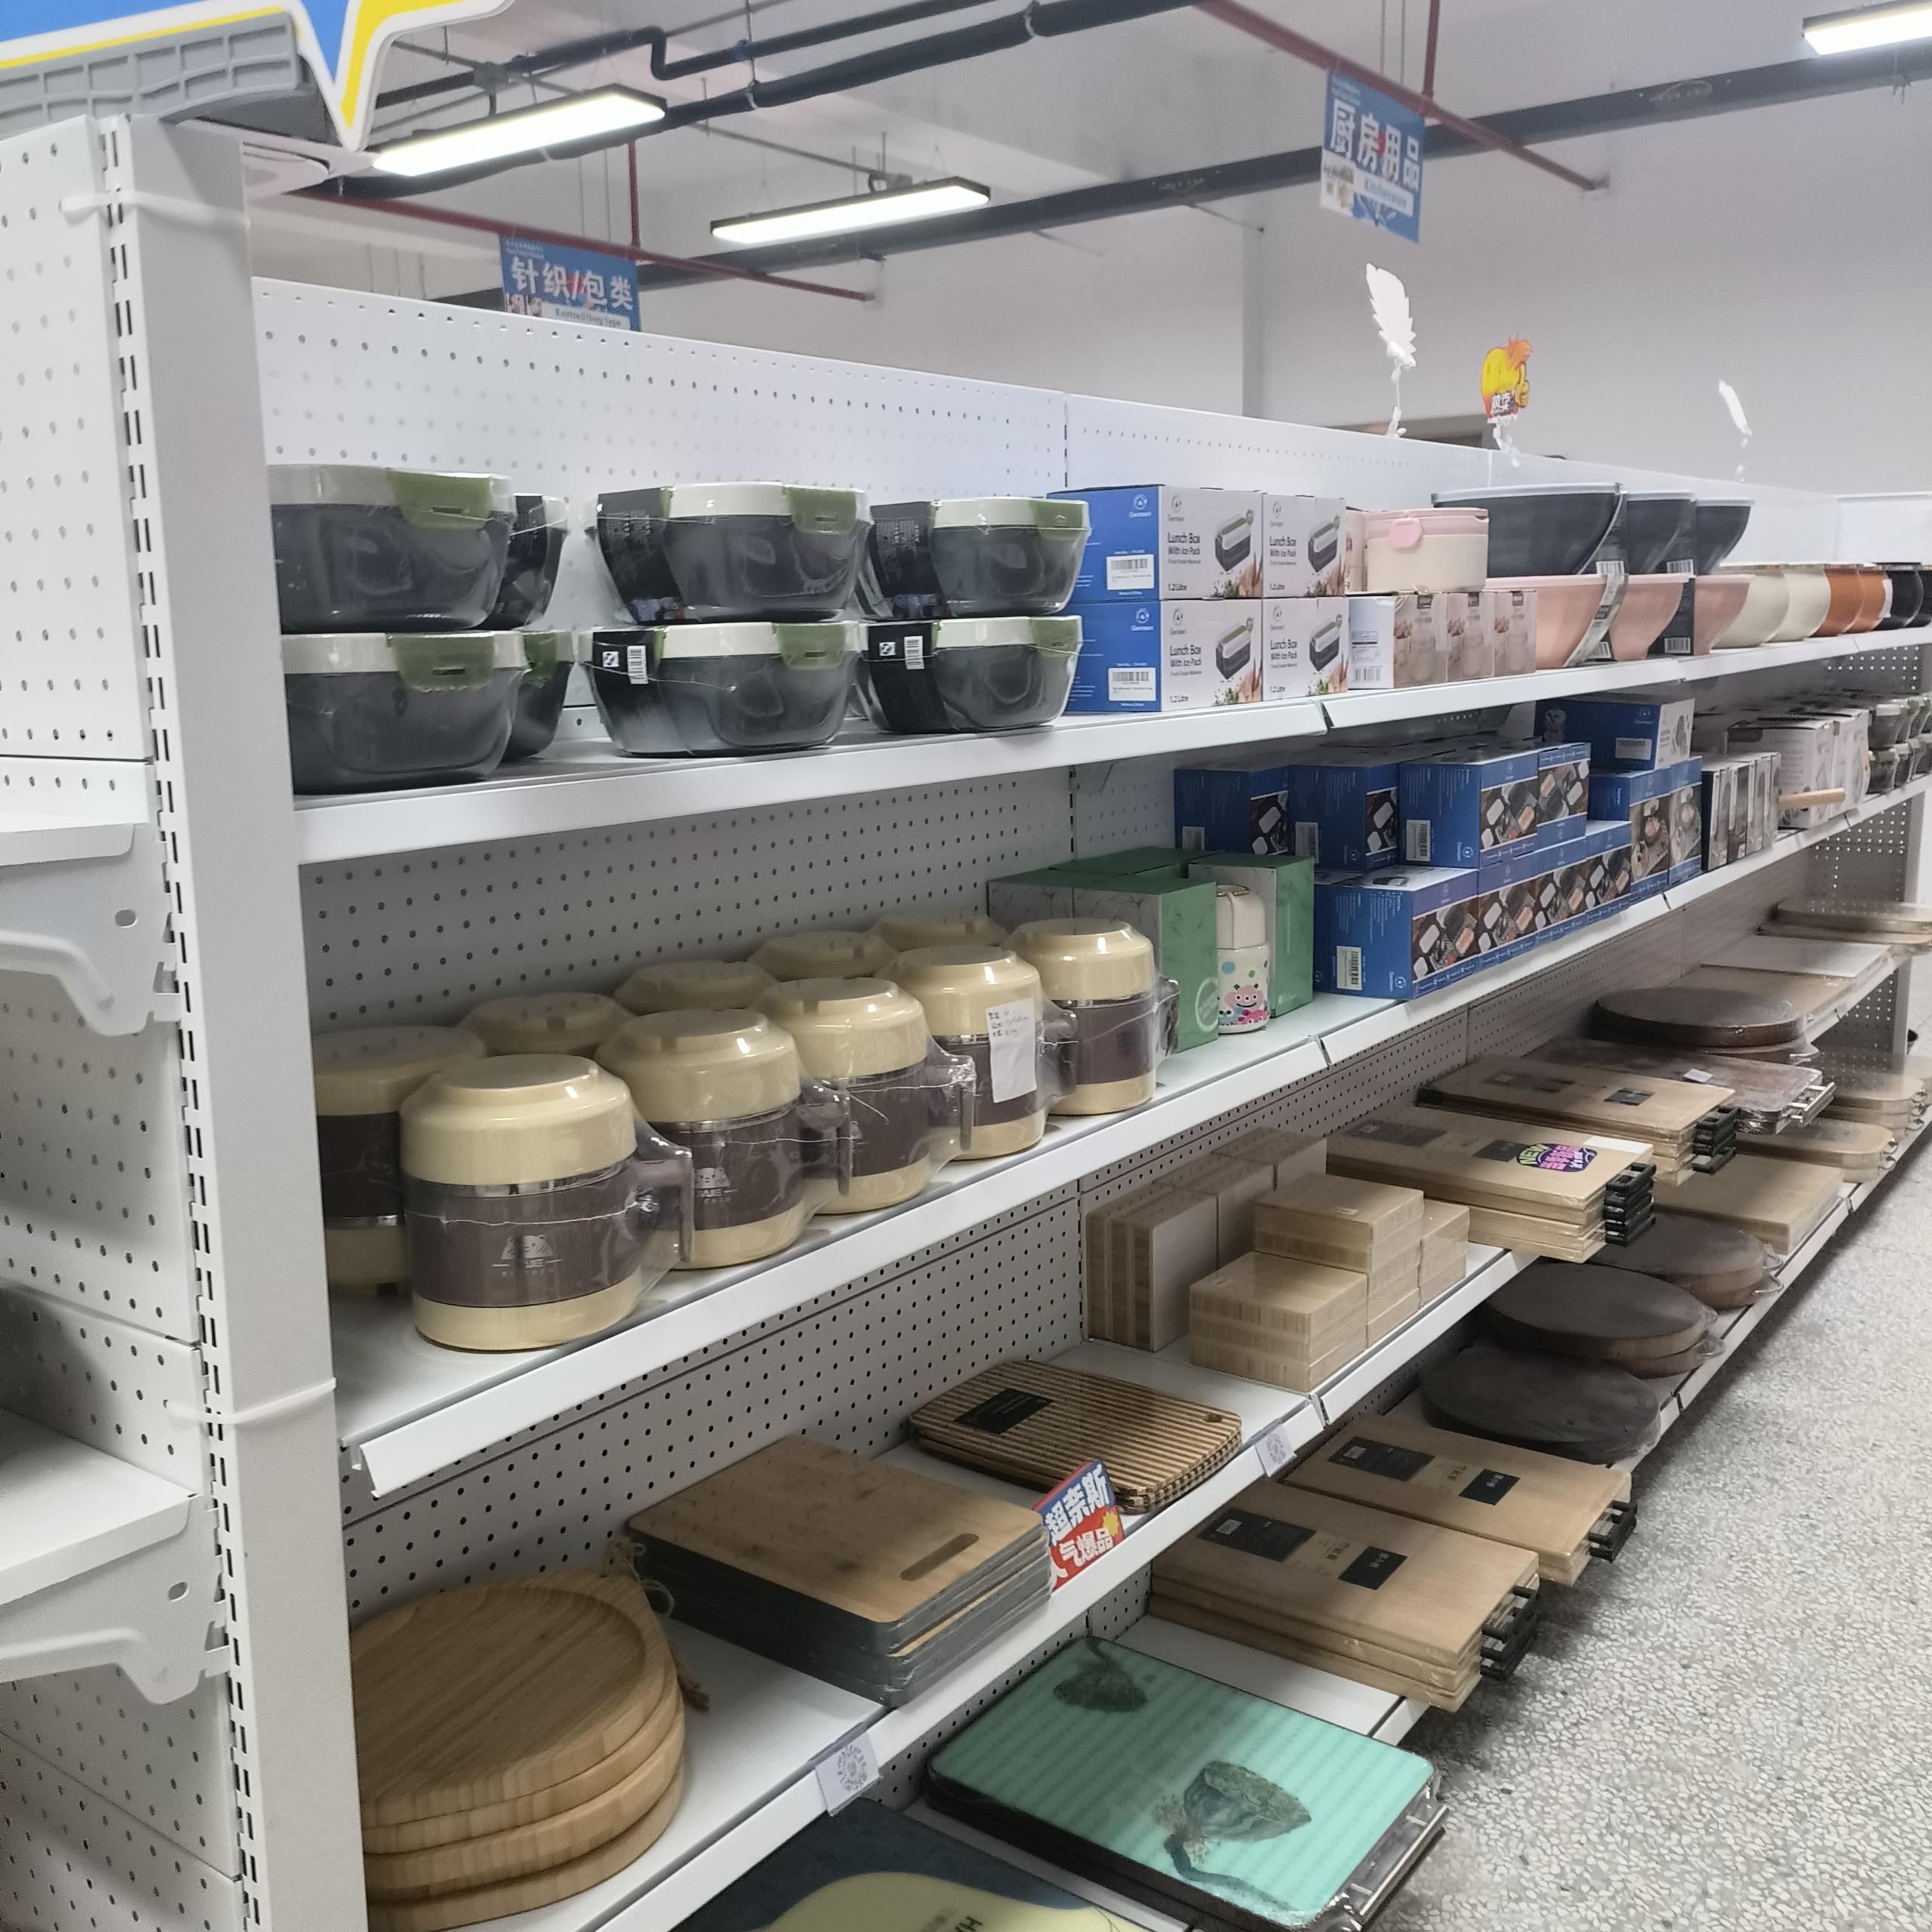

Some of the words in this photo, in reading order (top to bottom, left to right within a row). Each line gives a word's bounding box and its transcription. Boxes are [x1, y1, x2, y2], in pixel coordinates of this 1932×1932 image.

[1331, 99, 1420, 191] 厨房用品
[512, 256, 633, 310] 针织/包类
[1168, 531, 1188, 543] Lunch
[1189, 532, 1201, 543] Box
[1269, 535, 1286, 546] Lunch
[1287, 537, 1297, 546] Box
[1168, 546, 1180, 555] With
[1189, 546, 1201, 555] Pack
[1170, 644, 1189, 656] Lunch
[1190, 645, 1201, 655] Box
[1270, 638, 1287, 650] Lunch
[1287, 638, 1297, 649] Box
[1519, 1144, 1551, 1164] NEW
[1044, 1463, 1111, 1547] 超奈斯
[1049, 1527, 1114, 1593] 人气爆品
